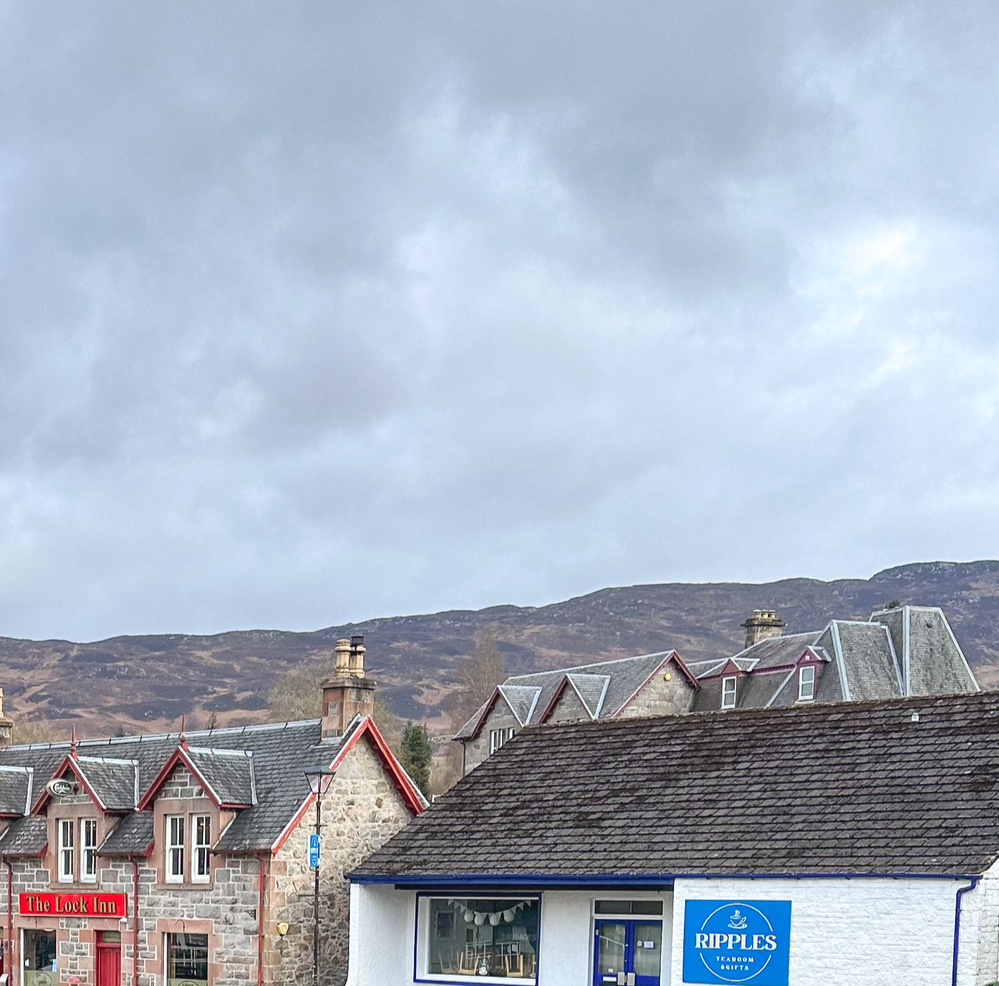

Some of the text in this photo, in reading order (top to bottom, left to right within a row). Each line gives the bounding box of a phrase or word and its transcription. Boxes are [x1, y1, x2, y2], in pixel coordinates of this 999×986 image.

[26, 896, 117, 913] The Lock Inn
[694, 933, 777, 951] RIPPLES
